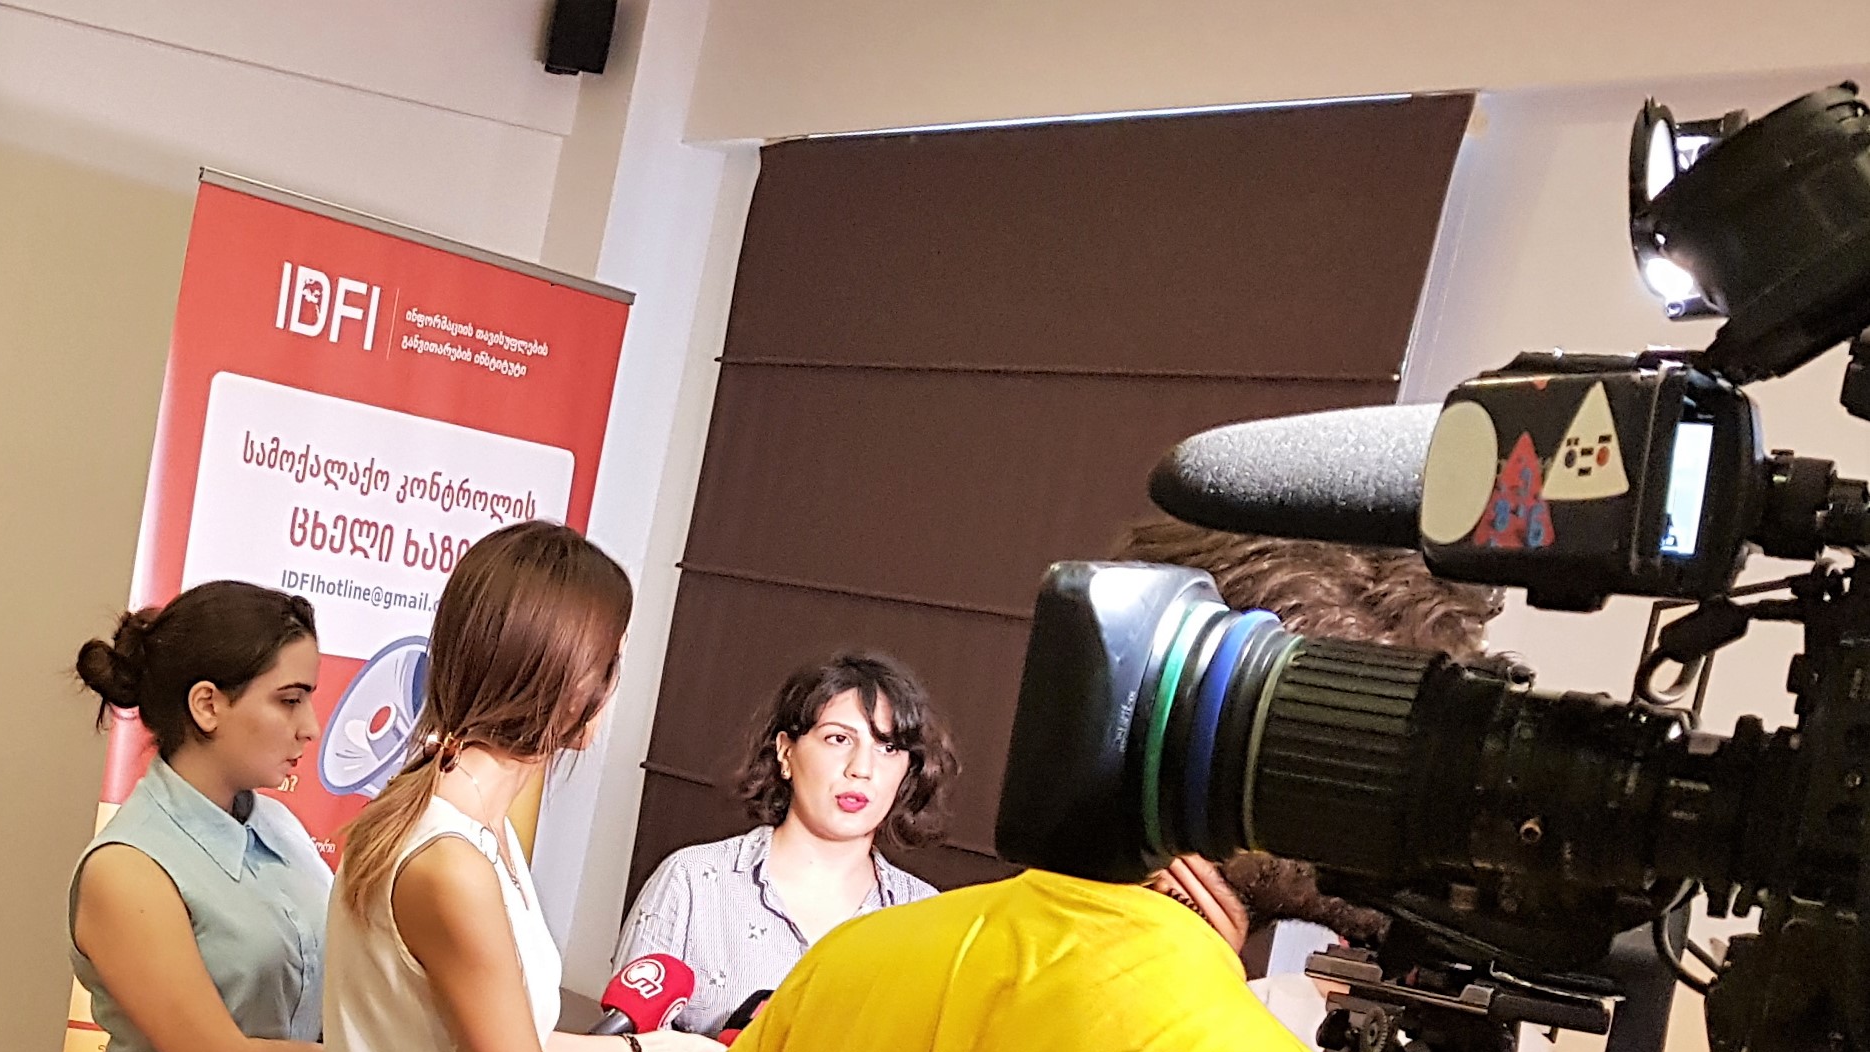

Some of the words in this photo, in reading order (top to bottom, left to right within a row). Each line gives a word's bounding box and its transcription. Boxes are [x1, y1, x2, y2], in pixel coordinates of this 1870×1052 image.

[275, 261, 382, 351] IDFI
[405, 308, 474, 336] ინფორმაციის
[475, 328, 549, 356] თავისუფლების
[401, 334, 472, 361] განვითარების
[474, 351, 528, 377] ინსტიტუტი
[242, 430, 390, 496] სამოქალაქო
[396, 471, 536, 523] კონტროლის
[289, 506, 395, 562] ცხელი
